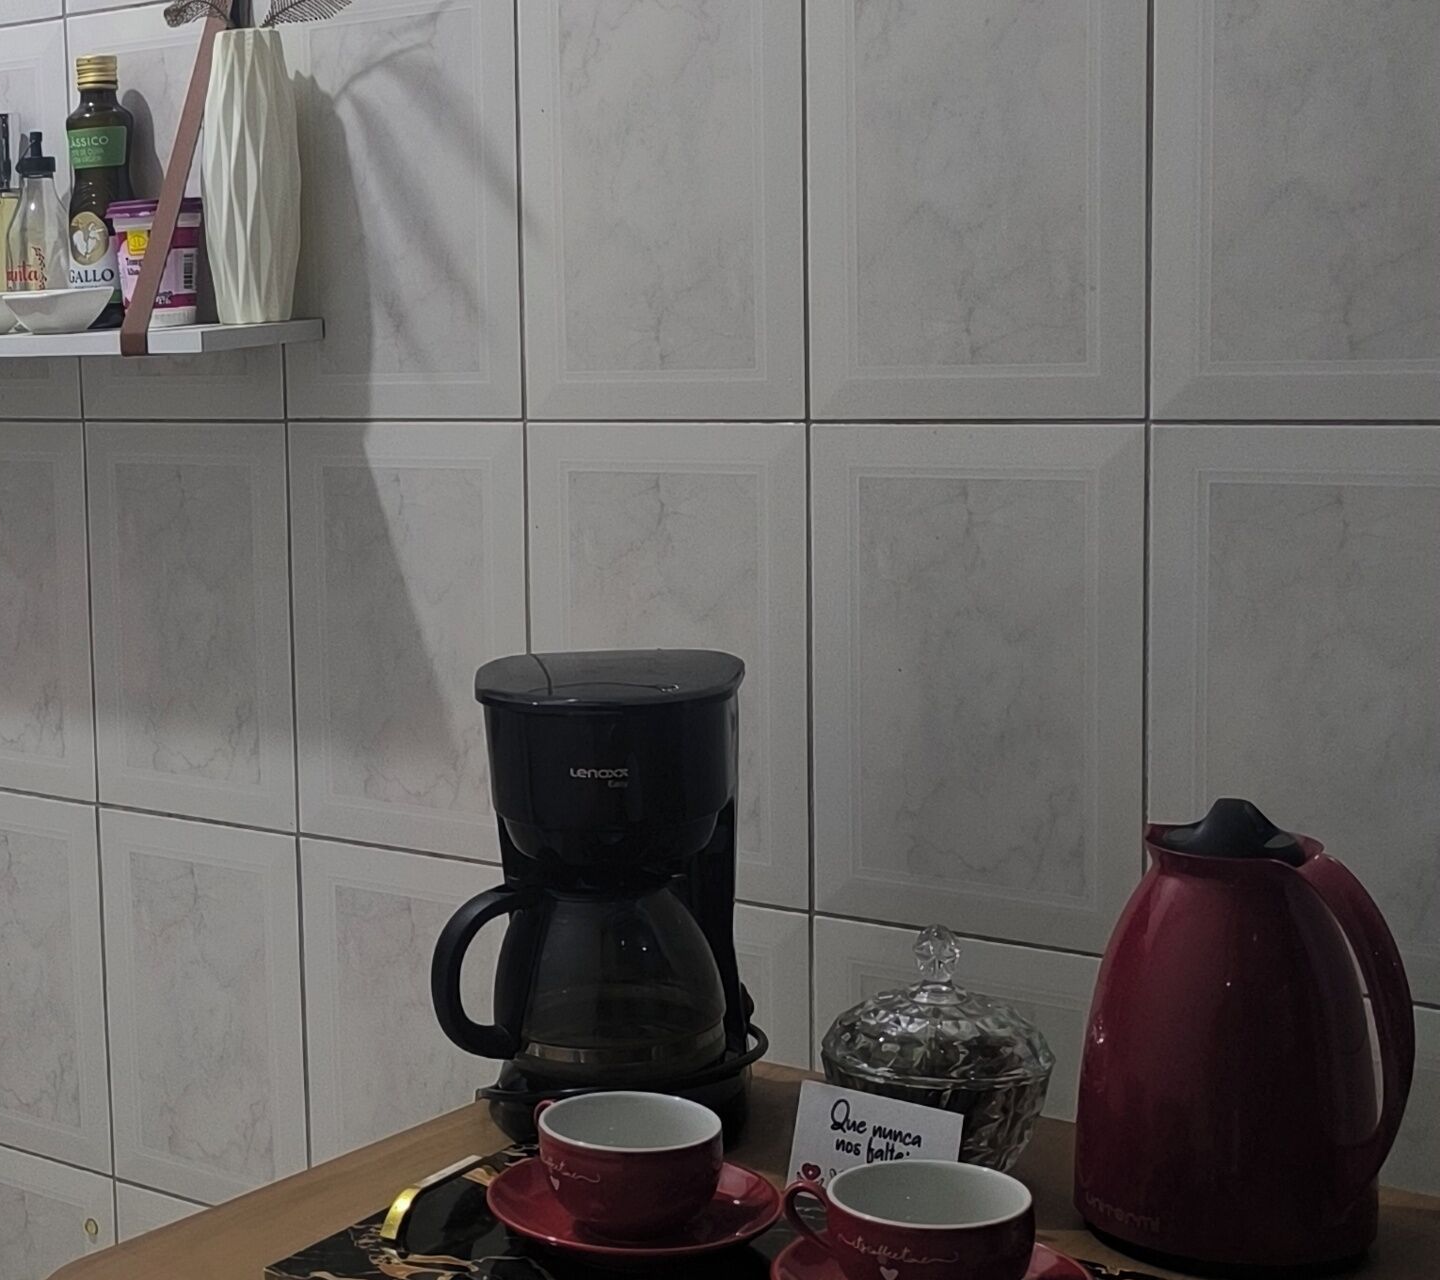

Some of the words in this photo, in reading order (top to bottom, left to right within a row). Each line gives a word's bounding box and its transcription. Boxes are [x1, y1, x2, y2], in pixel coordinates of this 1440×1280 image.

[69, 268, 114, 284] GALLO
[830, 1098, 868, 1134] Que
[871, 1124, 923, 1148] nunca
[835, 1138, 862, 1157] nos
